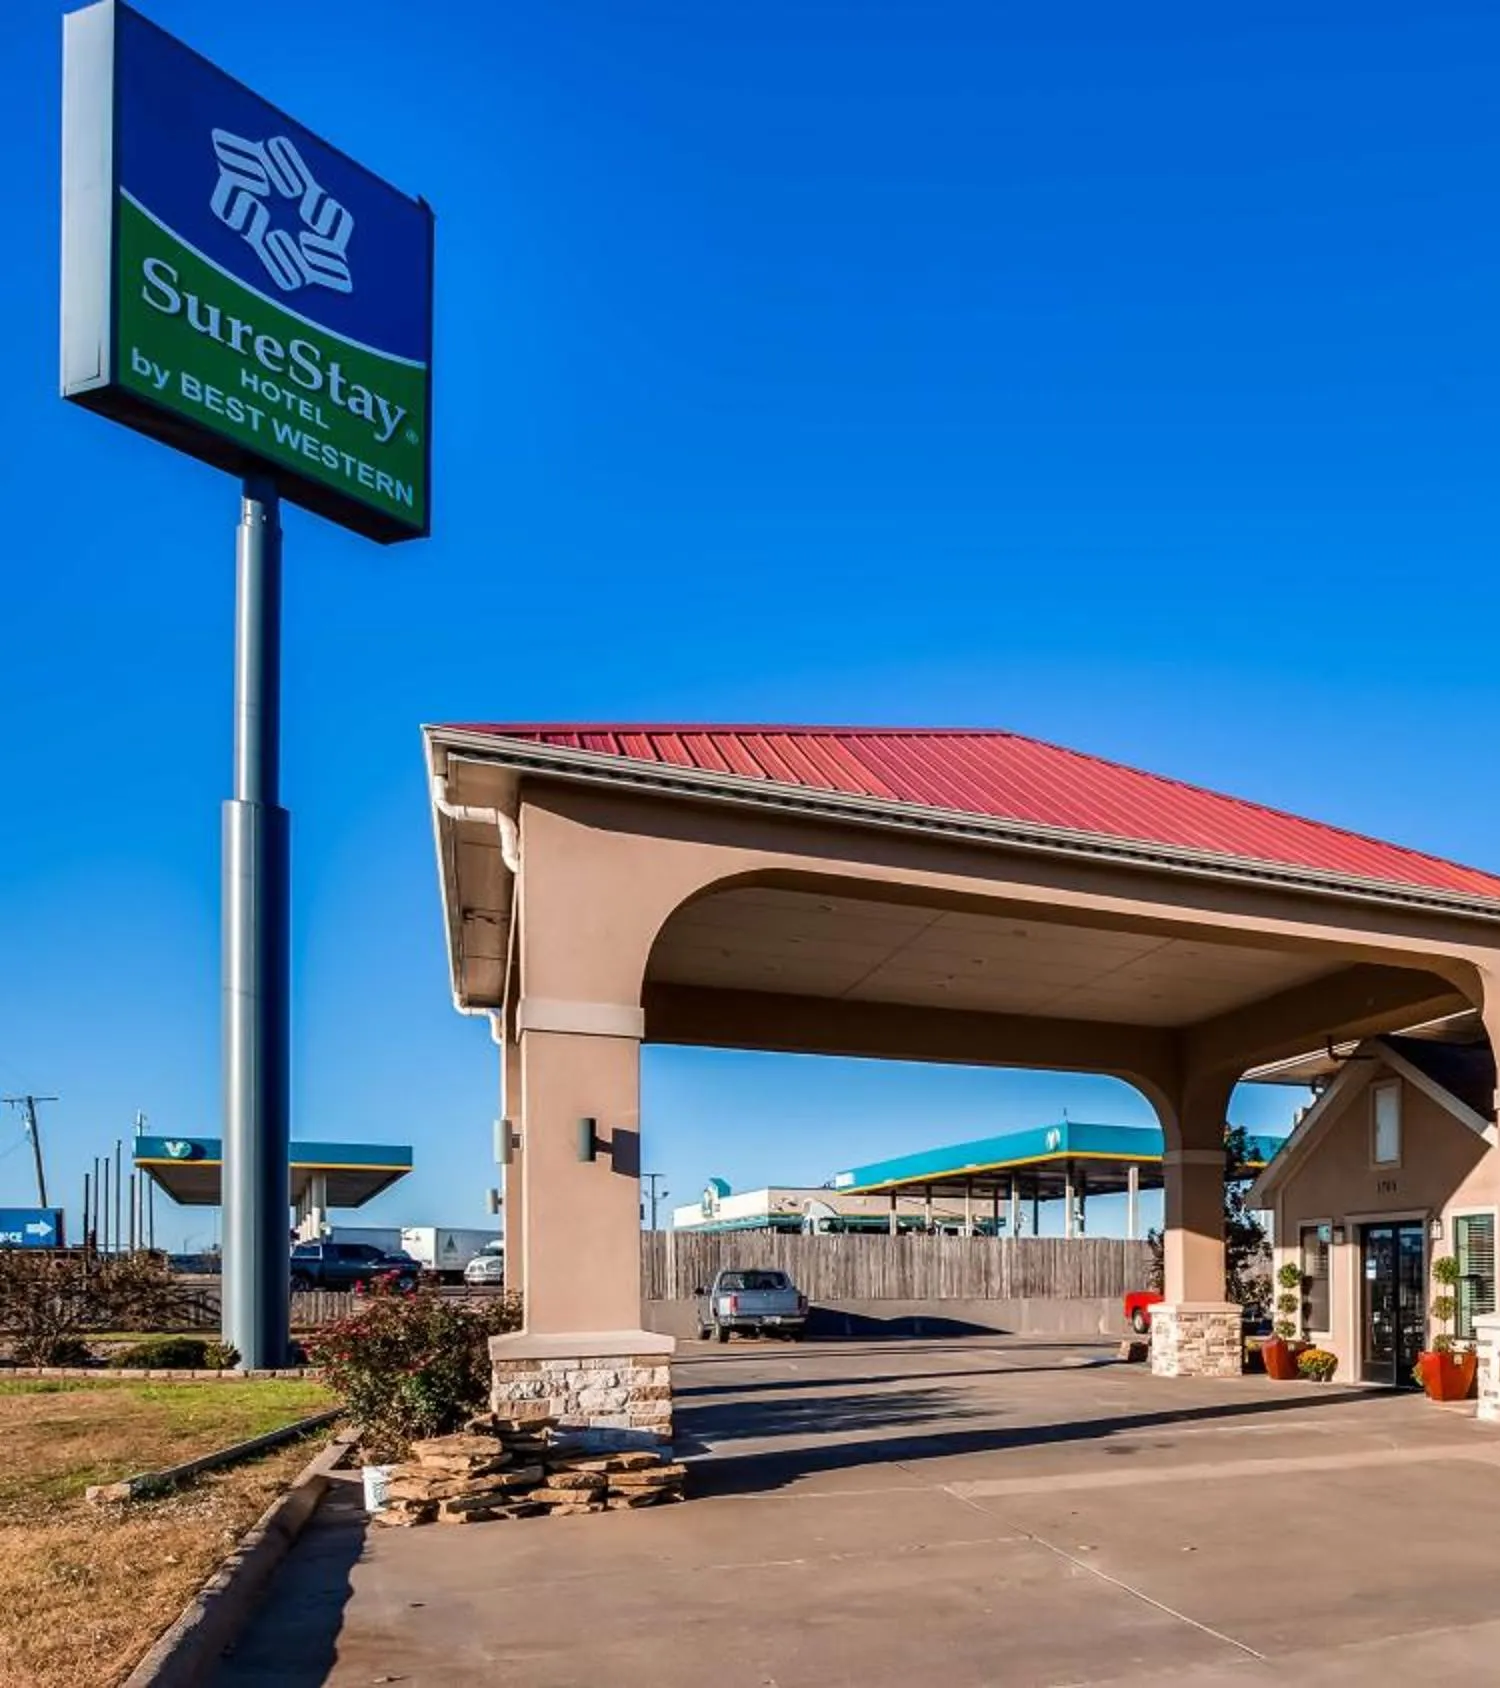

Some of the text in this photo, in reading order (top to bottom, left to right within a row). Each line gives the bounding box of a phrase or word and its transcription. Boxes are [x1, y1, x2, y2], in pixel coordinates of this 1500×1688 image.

[131, 346, 413, 508] by BEST WESTERN
[141, 256, 406, 443] SureStay
[240, 367, 331, 430] HOTEL
